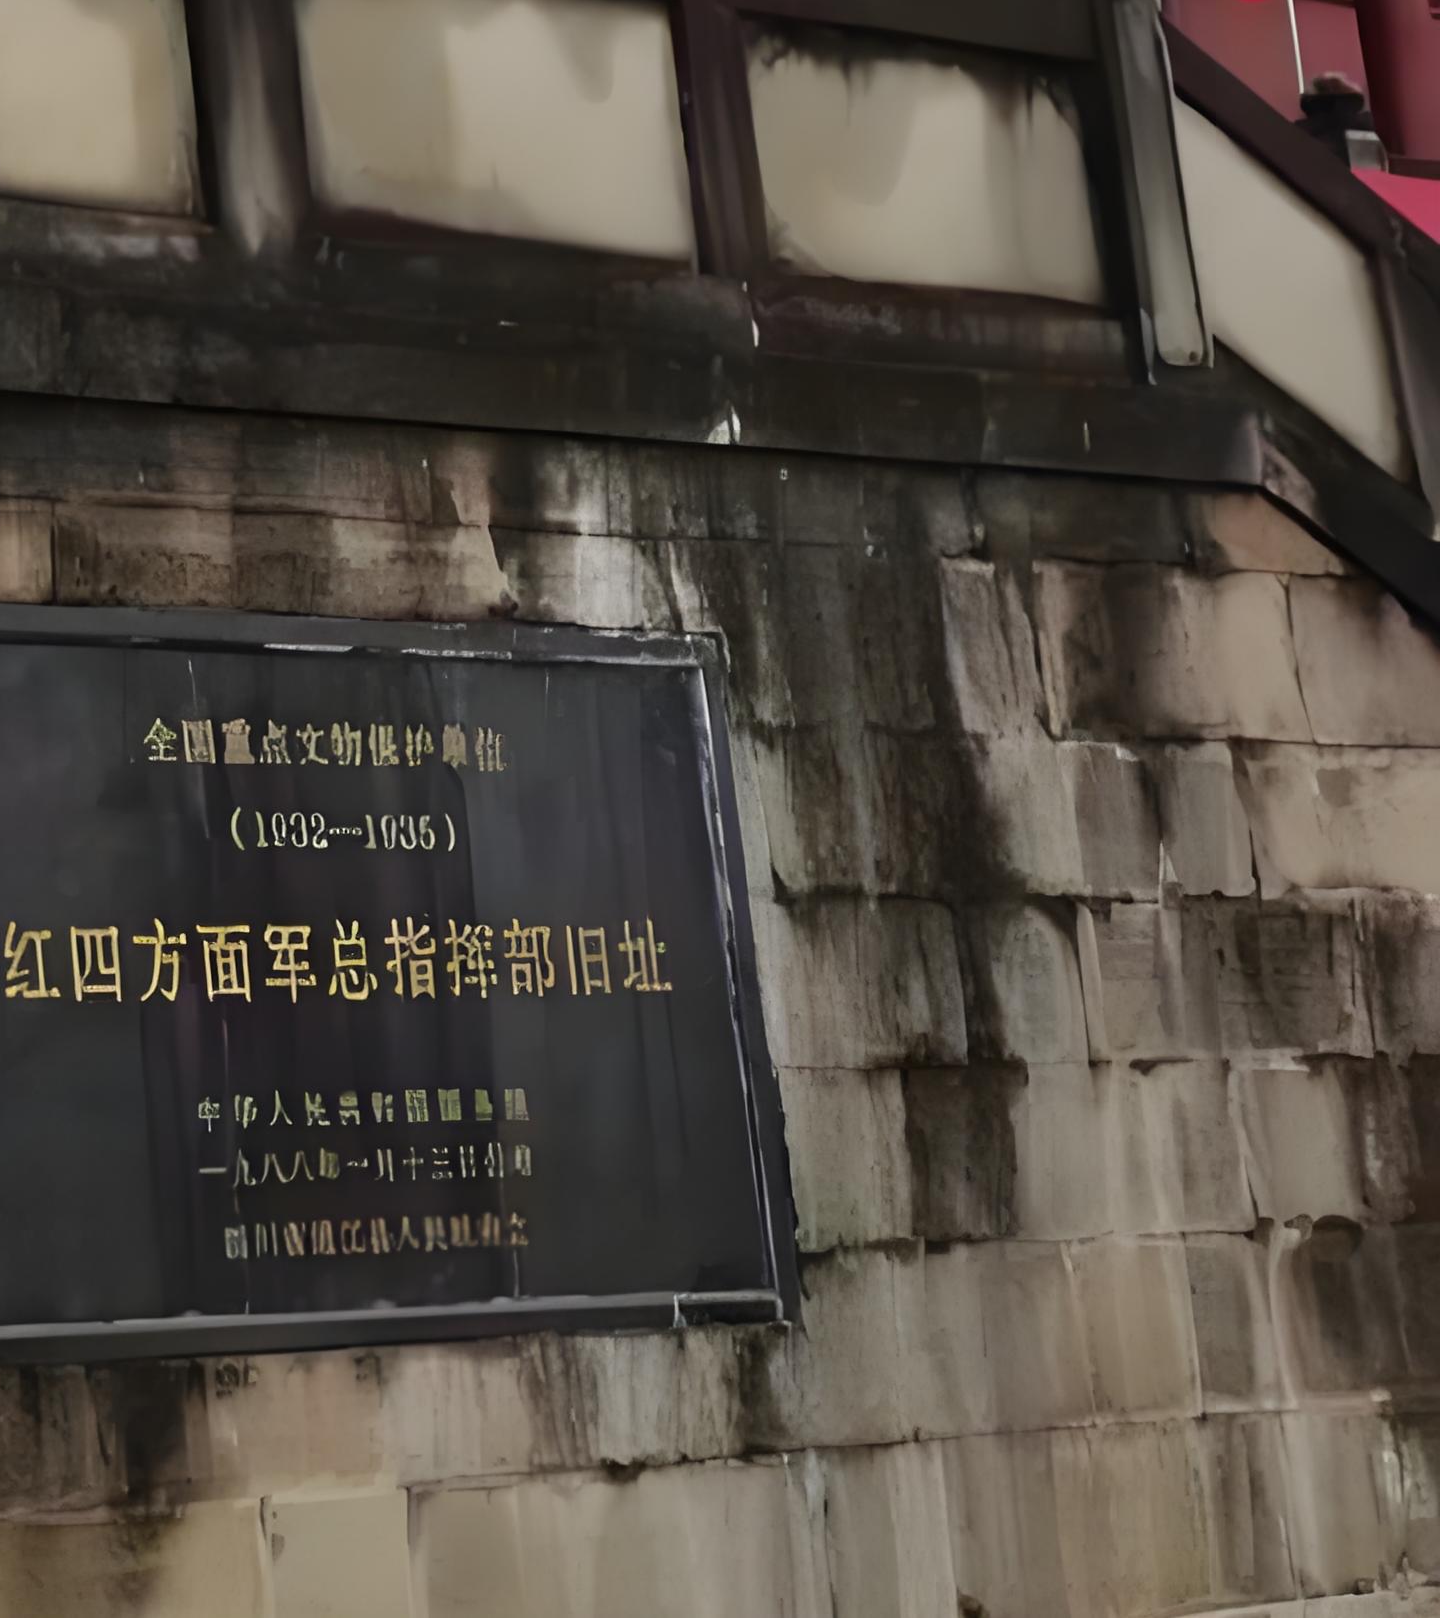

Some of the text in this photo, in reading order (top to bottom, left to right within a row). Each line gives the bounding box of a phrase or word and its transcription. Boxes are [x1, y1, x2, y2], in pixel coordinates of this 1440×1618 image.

[4, 916, 673, 1004] 红四方面军总指挥部旧址
